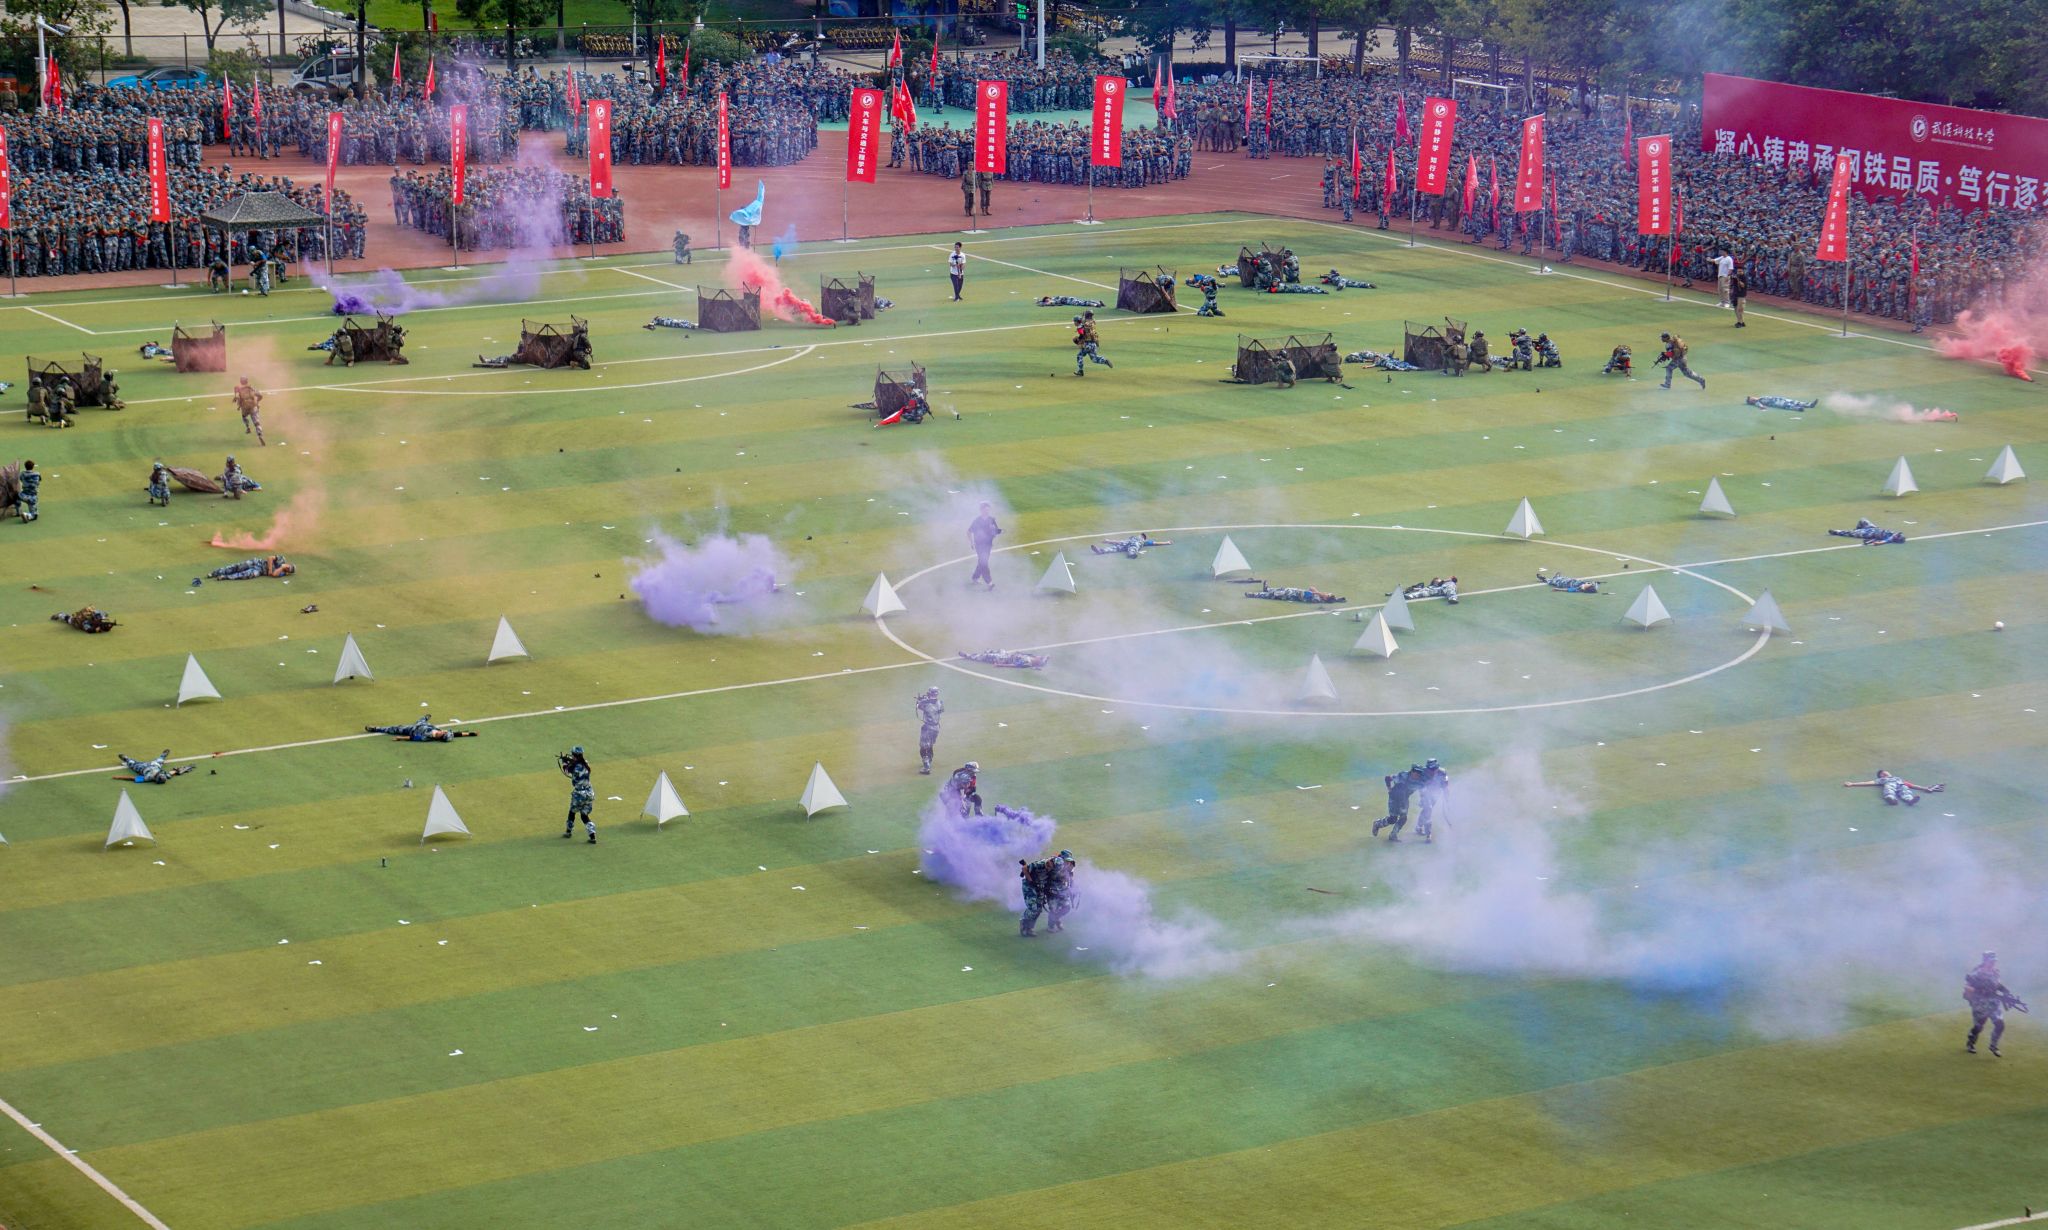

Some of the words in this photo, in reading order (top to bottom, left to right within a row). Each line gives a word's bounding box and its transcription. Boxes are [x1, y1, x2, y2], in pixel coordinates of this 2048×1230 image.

[856, 110, 870, 175] 汽车与交通工程学院
